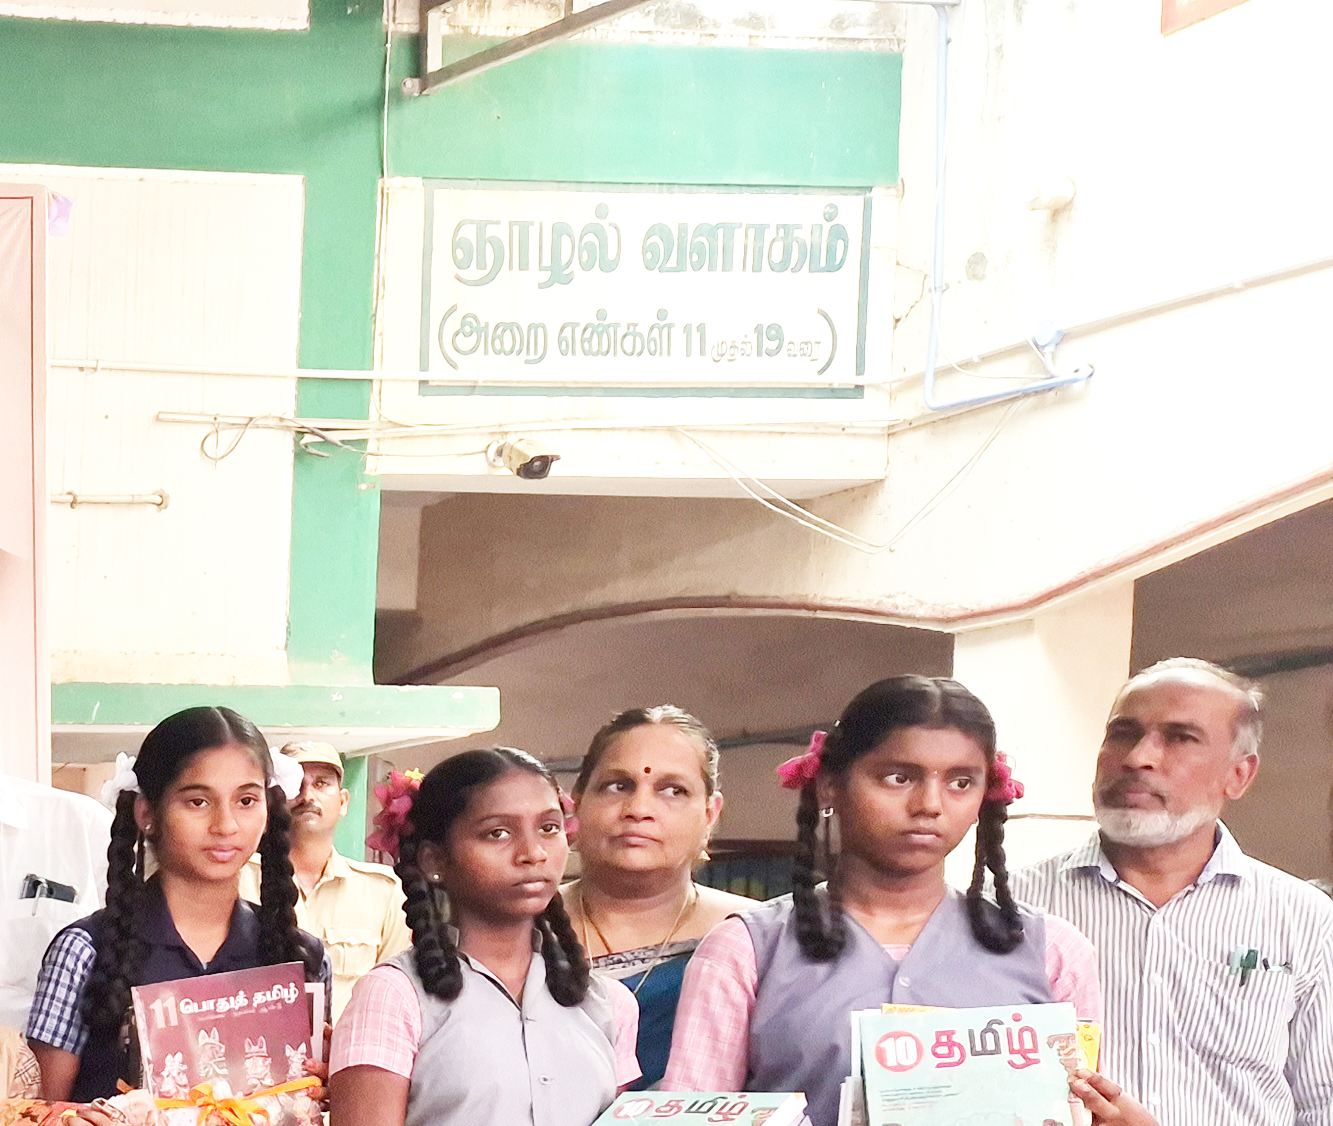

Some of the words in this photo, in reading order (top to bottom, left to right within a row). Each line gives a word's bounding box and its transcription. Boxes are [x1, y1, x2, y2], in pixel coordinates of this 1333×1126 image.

[451, 202, 622, 290] ஞாழல்
[641, 202, 850, 274] வளாகம்
[437, 303, 549, 372] (அறை
[557, 308, 676, 358] எண்கள்
[682, 322, 707, 357] 11
[754, 322, 785, 357] 19
[149, 996, 179, 1029] 11
[179, 990, 249, 1014] பொதுத்
[252, 982, 299, 1008] தமிழ்
[879, 1035, 918, 1067] 10
[931, 1012, 1041, 1069] தமிழ்
[652, 1094, 749, 1123] தமிழ்
